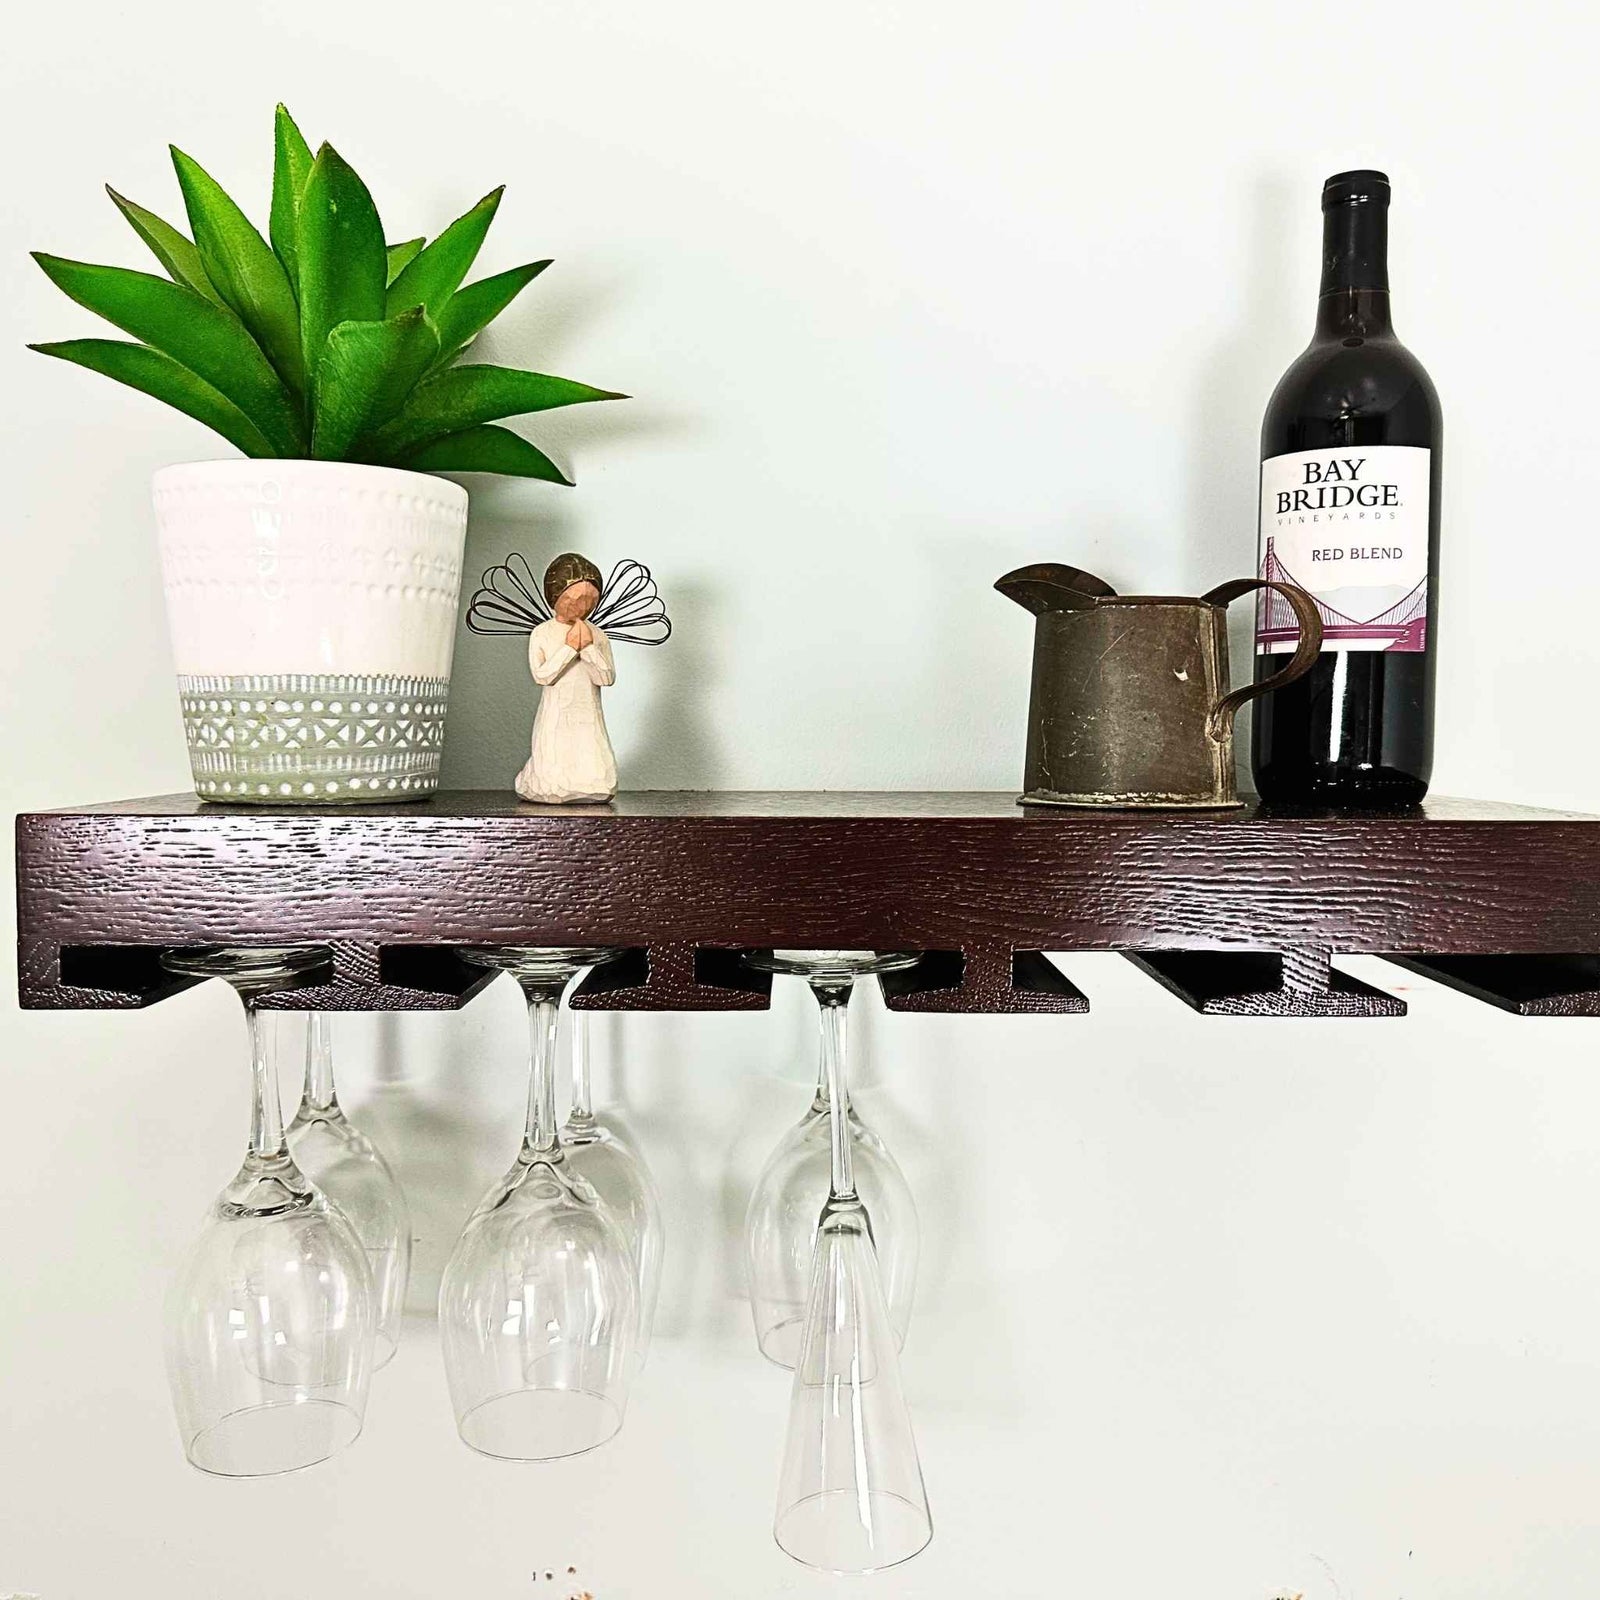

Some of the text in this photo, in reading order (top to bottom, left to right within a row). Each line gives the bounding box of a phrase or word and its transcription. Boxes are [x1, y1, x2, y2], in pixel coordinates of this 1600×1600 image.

[1302, 458, 1366, 485] BAY
[1276, 484, 1399, 514] BRIDGE
[1277, 511, 1396, 526] VINEYARDS
[1312, 547, 1403, 562] RED BLEND
